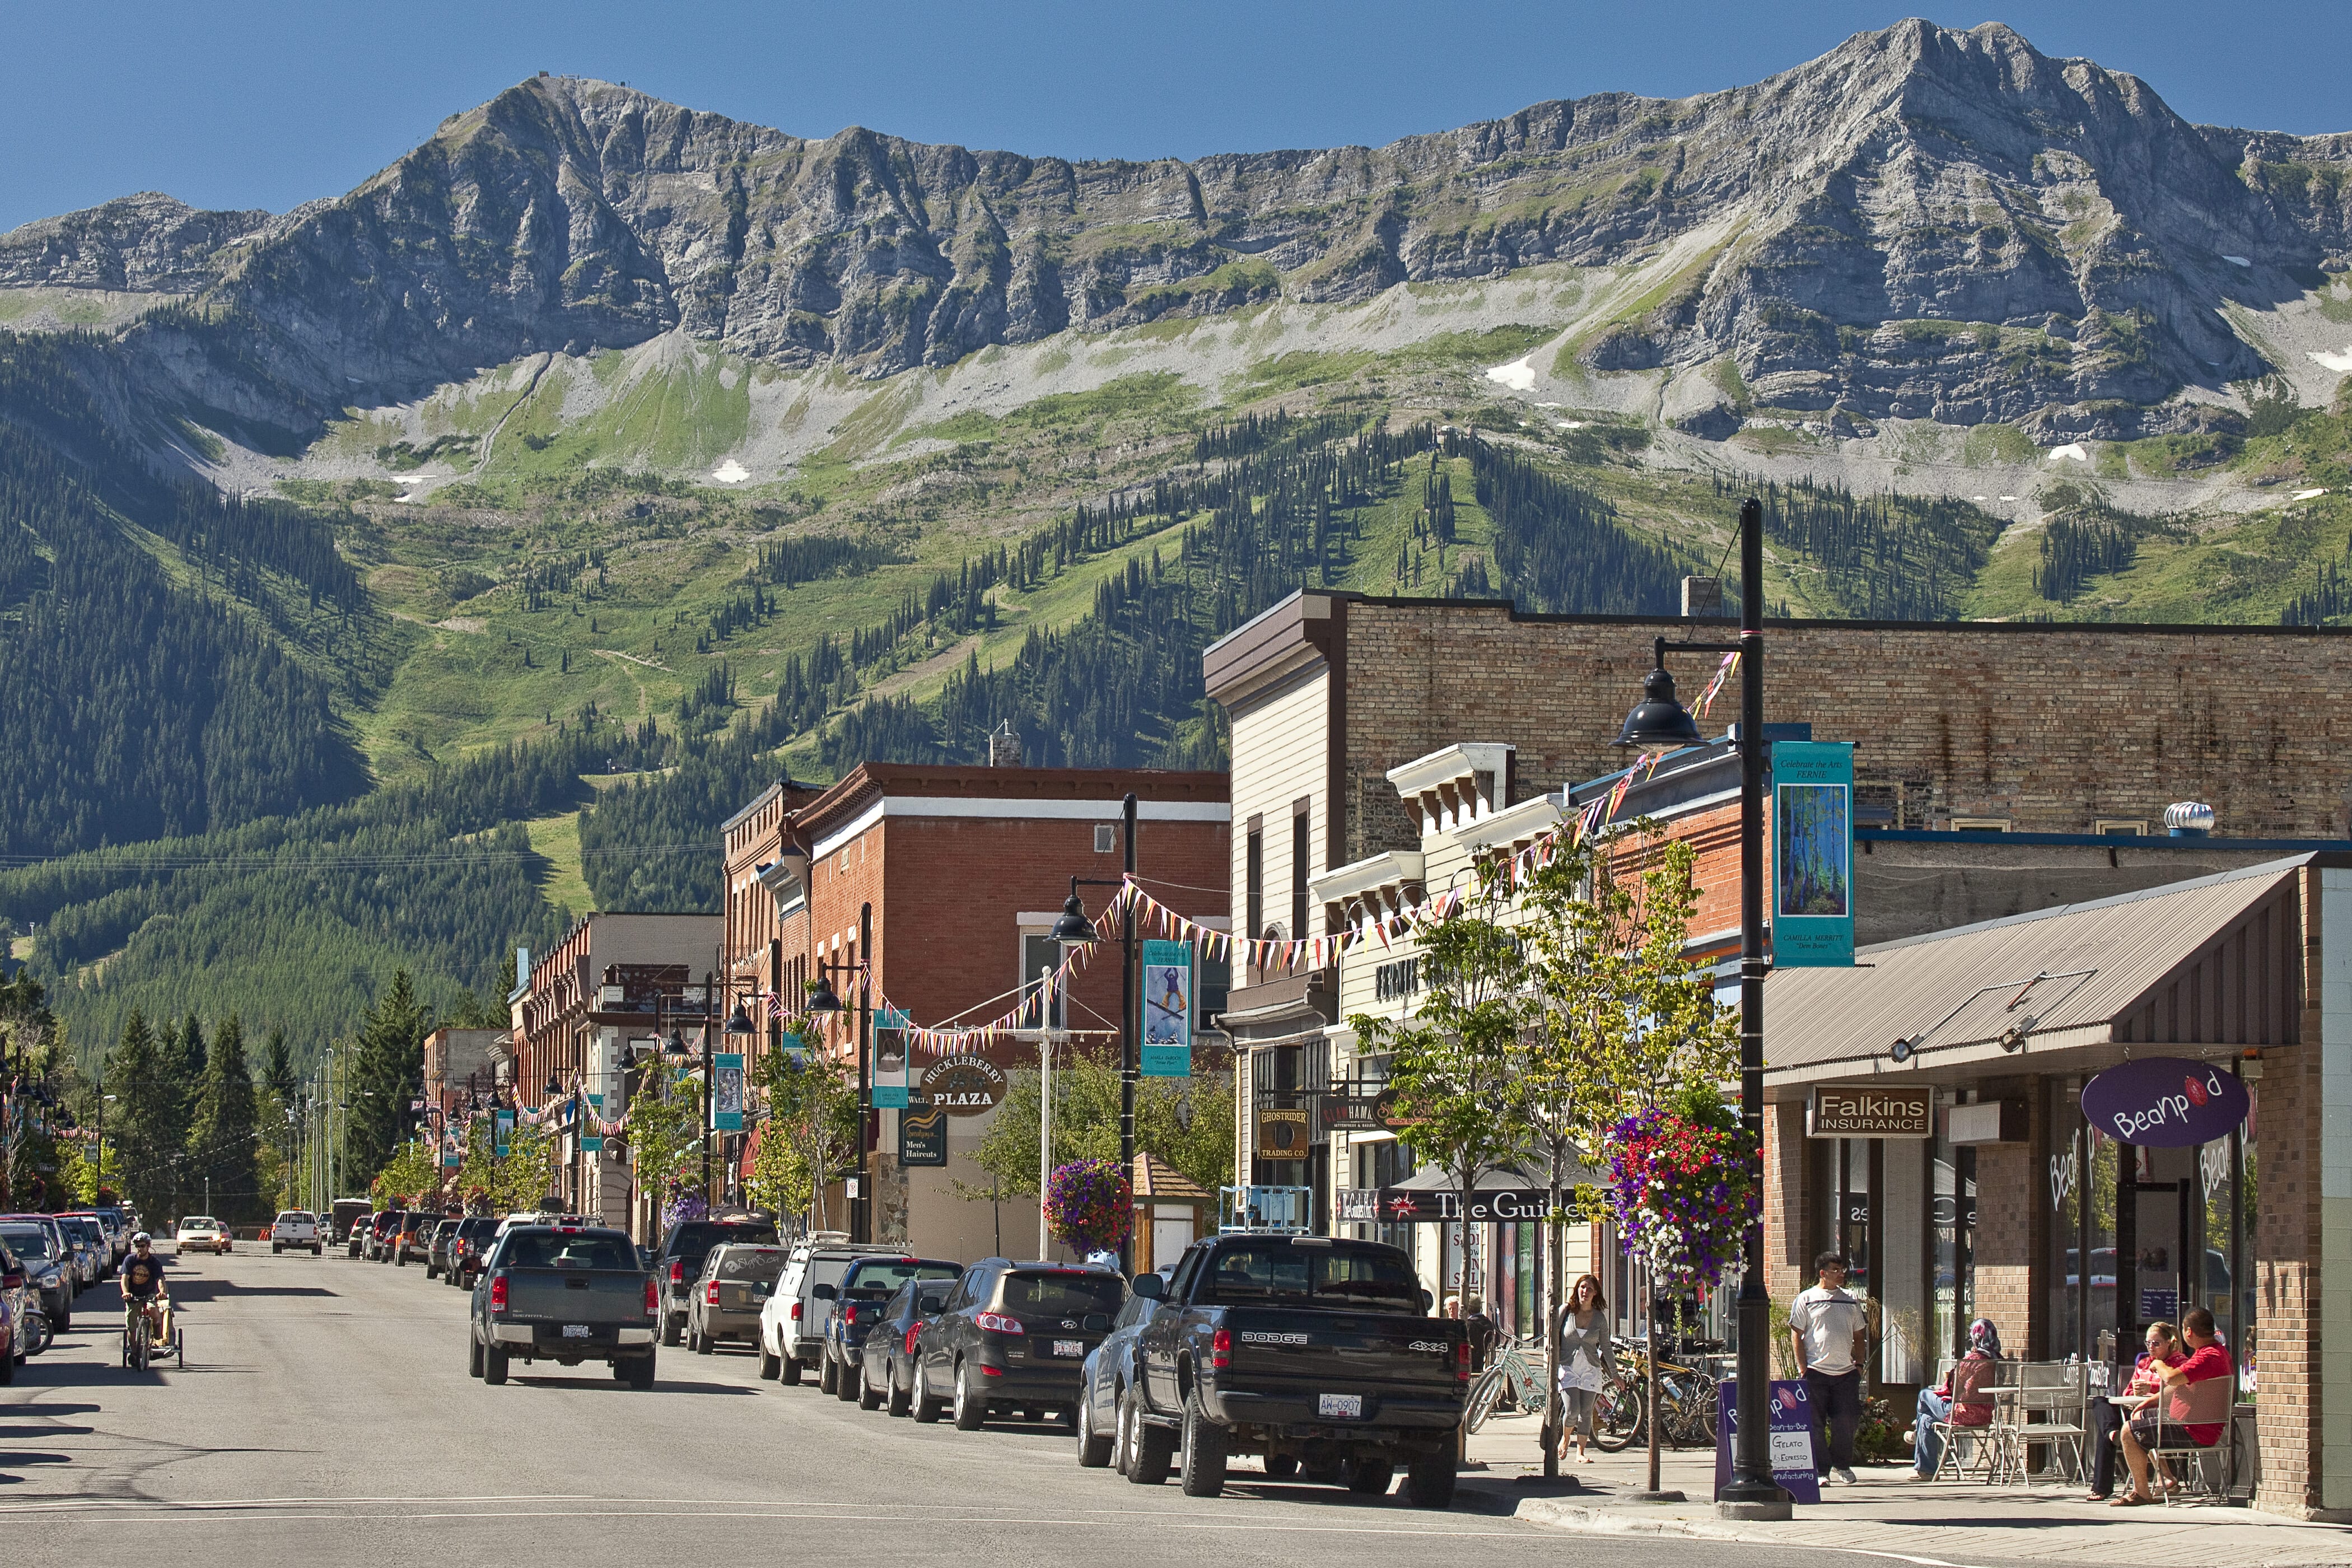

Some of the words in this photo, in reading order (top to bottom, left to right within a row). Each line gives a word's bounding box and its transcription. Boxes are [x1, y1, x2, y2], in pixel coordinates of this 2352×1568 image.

[1781, 759, 1814, 768] Celebrate
[1816, 760, 1824, 768] the
[1796, 770, 1827, 778] FERNIE
[925, 1056, 1004, 1085] HUCKLEBERRY
[934, 1093, 993, 1105] PLAZA
[1821, 1096, 1925, 1116] Falkins
[1261, 1112, 1306, 1124] GHOSTRIDER
[1821, 1119, 1925, 1130] INSURANCE
[906, 1150, 937, 1158] Haircuts
[1242, 1331, 1308, 1344] DODGE
[1773, 1471, 1814, 1480] anufacturing
